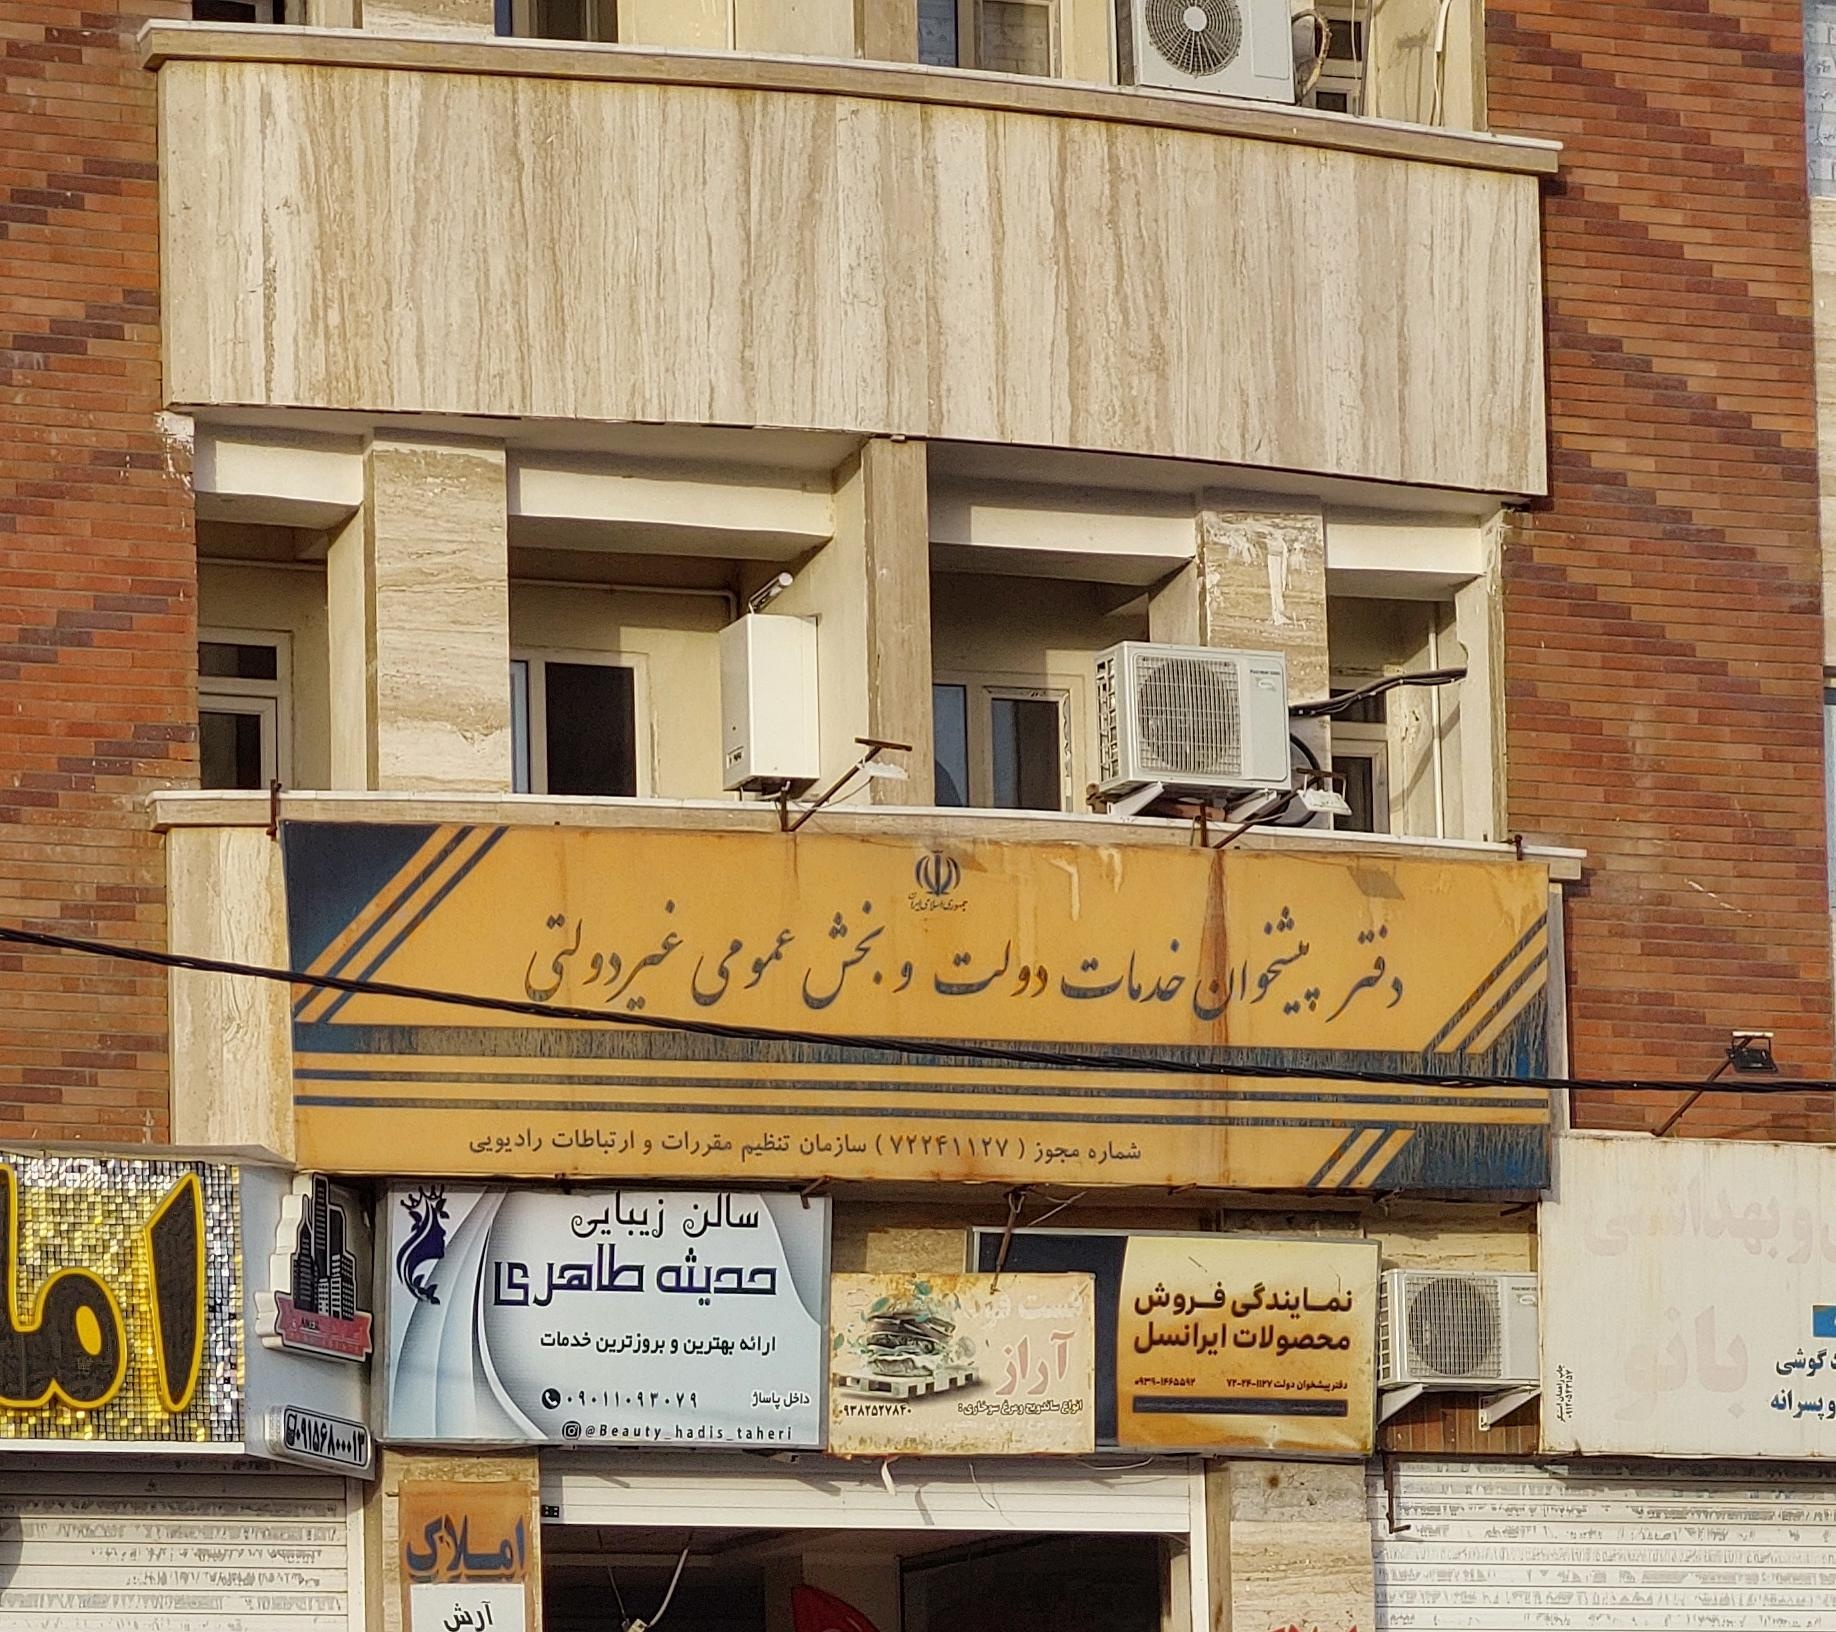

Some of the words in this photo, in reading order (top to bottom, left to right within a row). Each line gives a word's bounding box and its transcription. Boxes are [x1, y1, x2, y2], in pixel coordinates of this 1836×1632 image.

[691, 927, 795, 1007] عمومی
[802, 901, 885, 1010] بخش
[934, 940, 1048, 998] دولت
[1061, 939, 1185, 1002] خدمات
[1193, 907, 1318, 1021] پیشخوان
[893, 957, 914, 992] و
[1326, 925, 1402, 1022] دفتر
[469, 1127, 542, 1154] رادیویی
[552, 1128, 634, 1155] ارتباطات
[643, 1139, 653, 1155] و
[661, 1131, 732, 1157] مقررات
[741, 1131, 790, 1162] تنظیم
[799, 1133, 867, 1158] سازمان
[1035, 1142, 1080, 1165] مجوز
[1088, 1140, 1141, 1166] شماره
[571, 1189, 664, 1238] زیبایی
[683, 1192, 759, 1238] سالن
[493, 1243, 645, 1307] طاهری
[656, 1247, 777, 1306] حدیثه
[1134, 1281, 1226, 1316] فروش
[1231, 1281, 1353, 1319] نمایندگی
[540, 1331, 591, 1348] خدمات
[596, 1333, 665, 1355] بروزترین
[670, 1339, 679, 1353] و
[683, 1334, 735, 1356] بهترین
[740, 1335, 776, 1356] ارائه
[1134, 1321, 1227, 1356] ایرانسل
[1233, 1323, 1351, 1357] محصولات
[994, 1330, 1076, 1396] آراز
[1776, 1347, 1827, 1377] گوشی
[752, 1390, 781, 1410] پاساژ
[784, 1391, 810, 1407] داخل
[1273, 1379, 1295, 1391] دولت
[1331, 1379, 1348, 1391] دفتر
[1060, 1398, 1083, 1414] انواع
[406, 1513, 525, 1572] املاک
[443, 1600, 493, 1632] آرش
